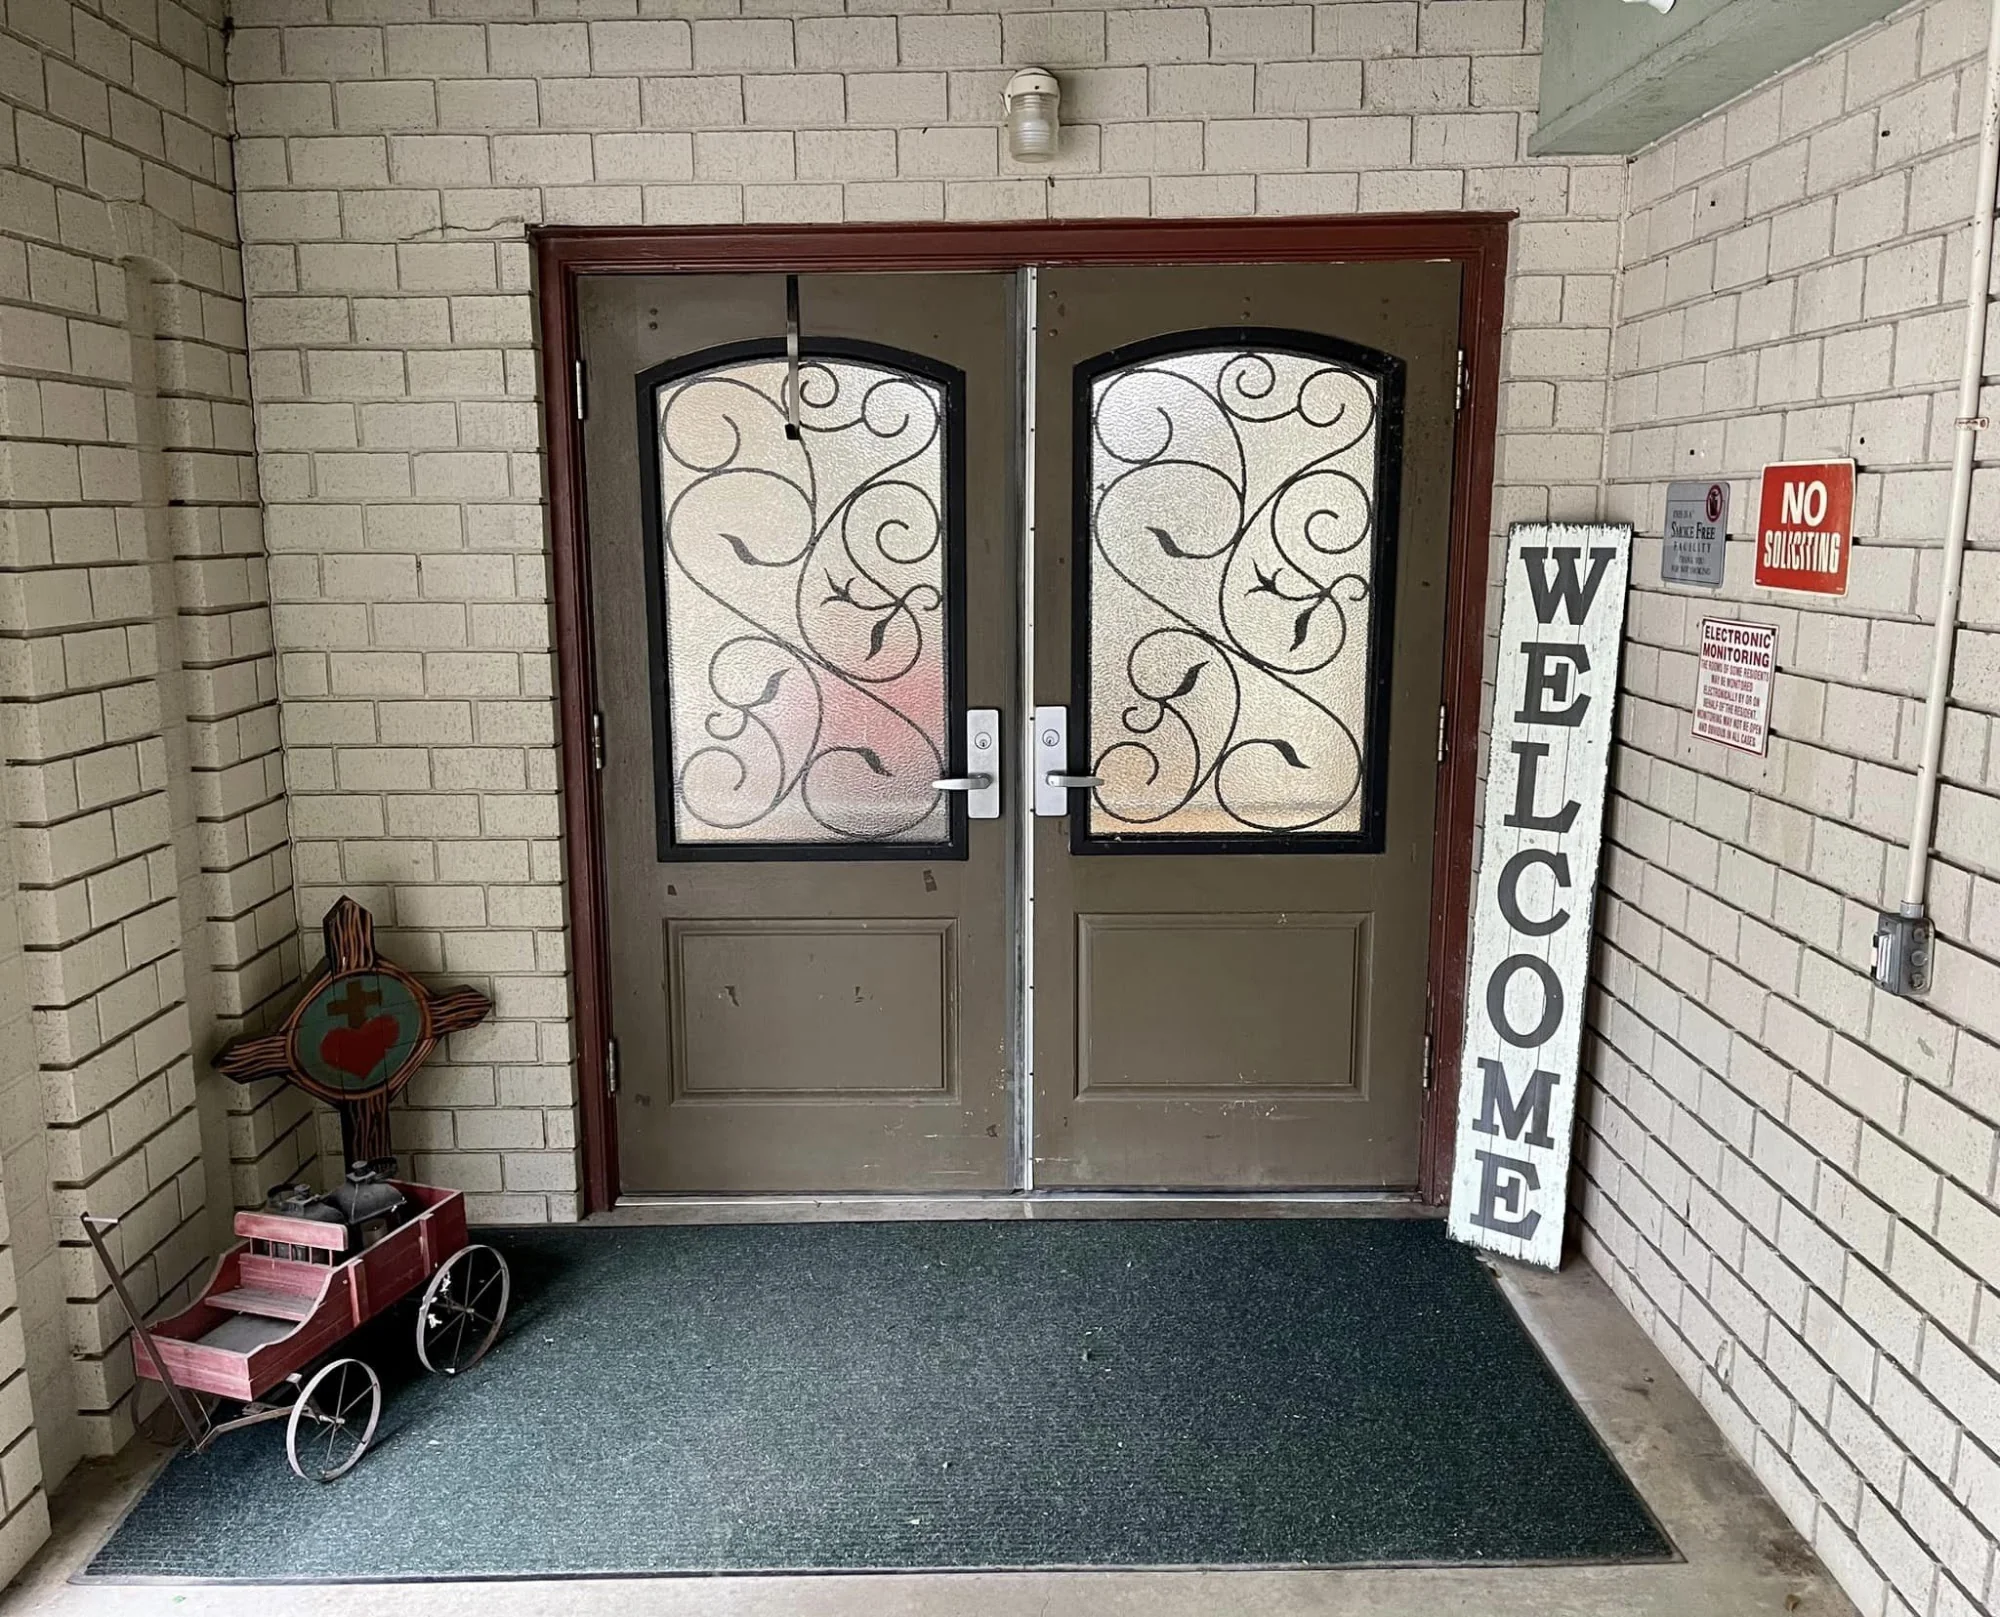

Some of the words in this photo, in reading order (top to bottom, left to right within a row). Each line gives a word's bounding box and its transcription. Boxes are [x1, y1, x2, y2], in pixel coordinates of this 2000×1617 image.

[1781, 480, 1828, 527] NO
[1671, 521, 1694, 539] SMOKE
[1696, 522, 1716, 540] FREE
[1673, 541, 1711, 553] FACILITY
[1763, 530, 1841, 574] SOLICITING
[1705, 625, 1771, 649] ELECTRONIC
[1703, 642, 1770, 668] MONITORING
[1709, 660, 1722, 673] ROOMS
[1724, 663, 1729, 674] OF
[1730, 664, 1742, 677] SOME
[1743, 667, 1769, 682] RESIDENTS
[1711, 674, 1720, 685] MAY
[1721, 676, 1726, 687] BE
[1727, 677, 1753, 692] MONITORED
[1703, 684, 1737, 702] ELECTRONICALLY
[1738, 693, 1744, 704] BY
[1745, 694, 1752, 705] OR
[1753, 696, 1760, 707] ON
[1703, 697, 1718, 710] BEHALF
[1719, 701, 1725, 712] OF
[1725, 702, 1733, 714] THE
[1697, 708, 1722, 725] MONITORING
[1723, 715, 1732, 727] MAY
[1733, 718, 1742, 729] NOT
[1743, 720, 1749, 731] BE
[1749, 722, 1761, 735] OPEN
[1698, 721, 1707, 733] AND
[1727, 728, 1731, 740] IN
[1732, 731, 1740, 742] ALL
[1470, 547, 1616, 1240] WELCOME
